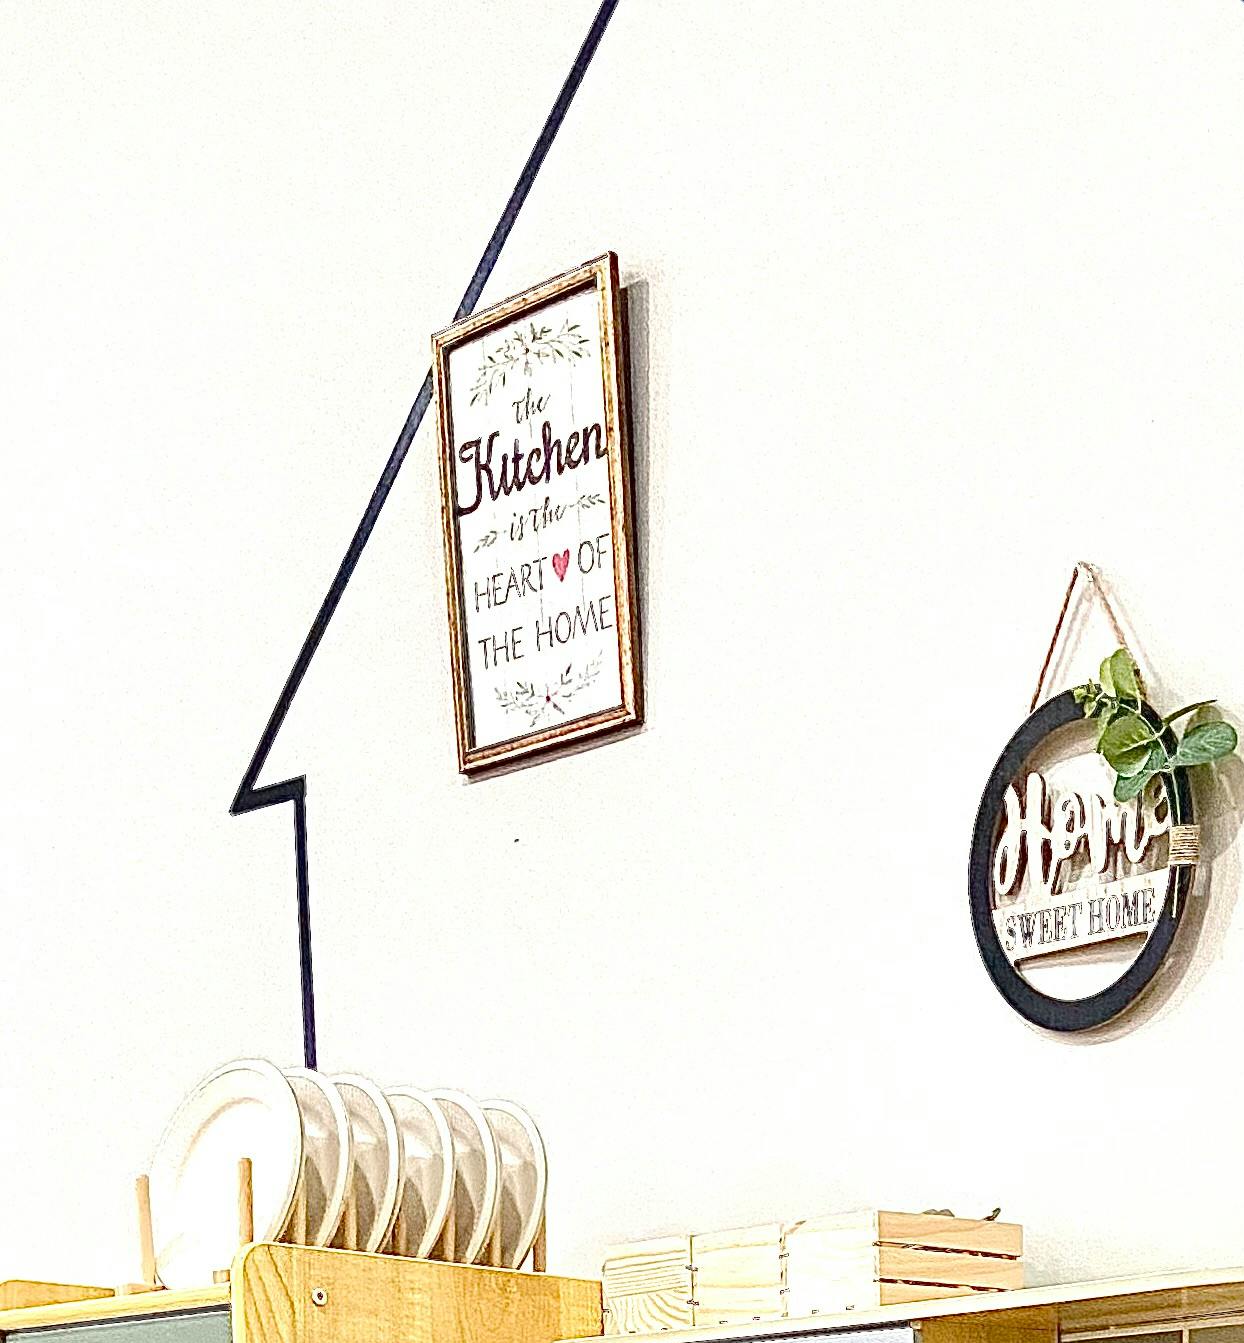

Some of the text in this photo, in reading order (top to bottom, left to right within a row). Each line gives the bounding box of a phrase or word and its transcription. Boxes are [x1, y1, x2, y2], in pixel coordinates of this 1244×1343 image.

[456, 421, 609, 517] Kitchen
[474, 533, 610, 613] HEART OF
[478, 594, 613, 670] THE HOME
[993, 771, 1171, 897] Home
[1005, 887, 1156, 951] SWEET HOME
